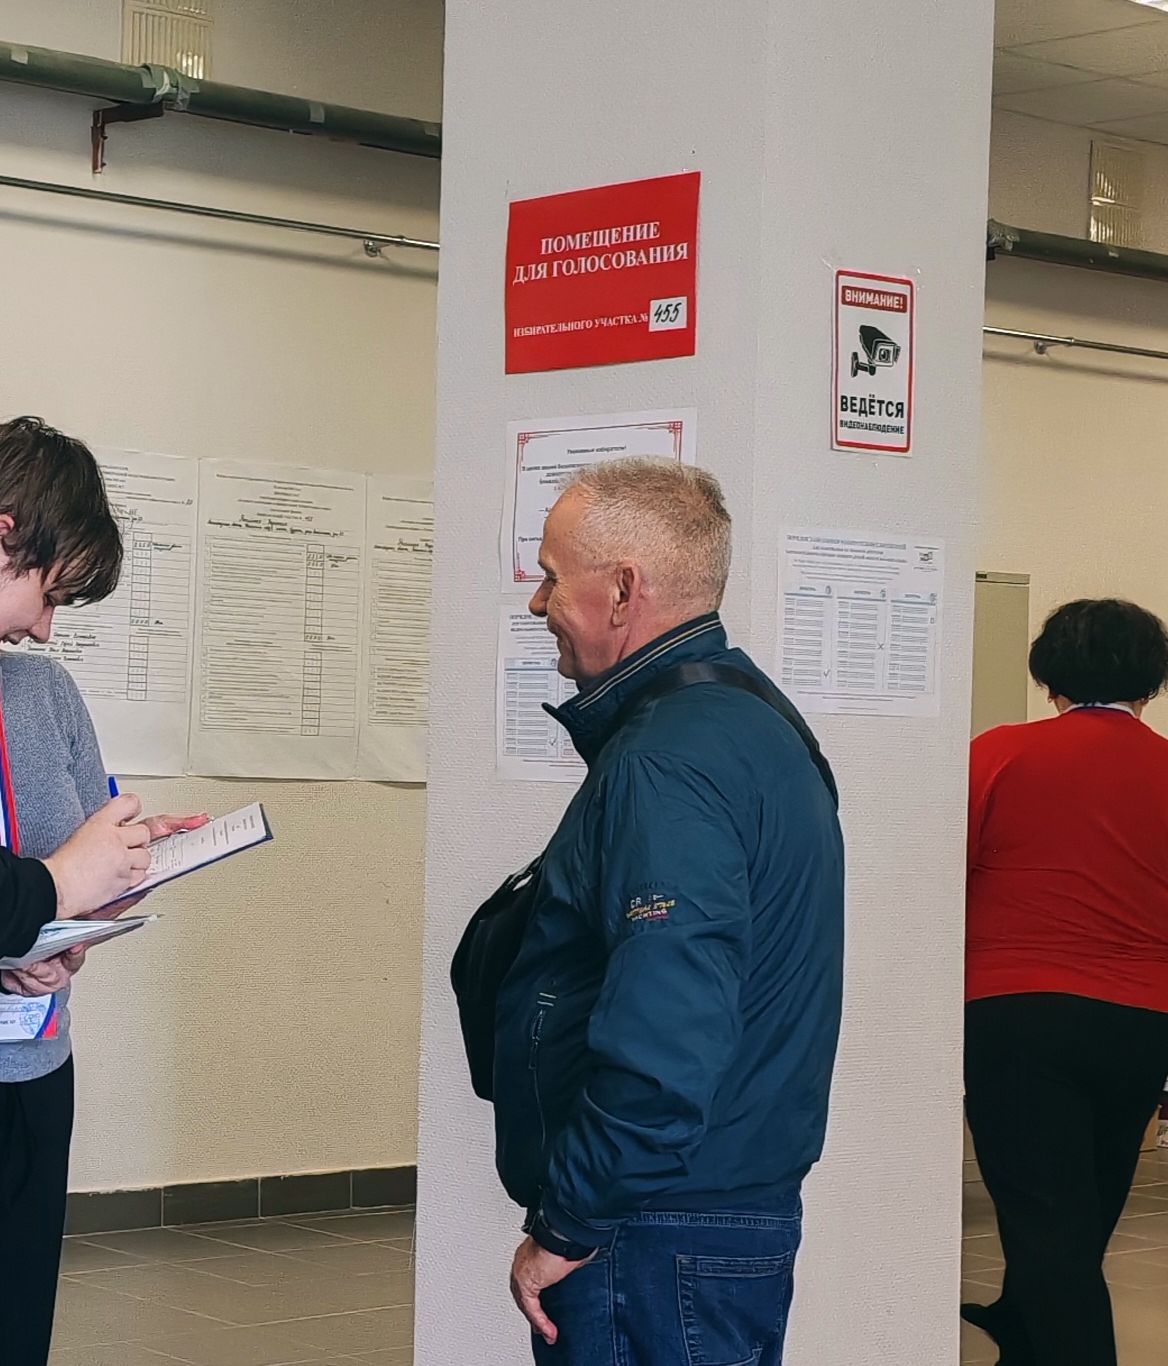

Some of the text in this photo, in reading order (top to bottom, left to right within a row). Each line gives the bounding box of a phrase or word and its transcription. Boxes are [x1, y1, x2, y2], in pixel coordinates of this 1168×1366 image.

[540, 221, 660, 255] ПОМЕЩЕНИЕ
[513, 242, 689, 286] ДЛЯ ГОЛОСОВАНИЯ
[845, 289, 904, 309] ВНИМАНИЕ!
[513, 319, 593, 338] ИЗБИРАТЕЛЬНОГО
[594, 314, 637, 328] УЧАСТКА
[653, 302, 682, 323] 455
[840, 394, 904, 419] ВЕДЁТСЯ
[839, 419, 904, 435] ВИДЕОНАБЛЮДЕНИЕ
